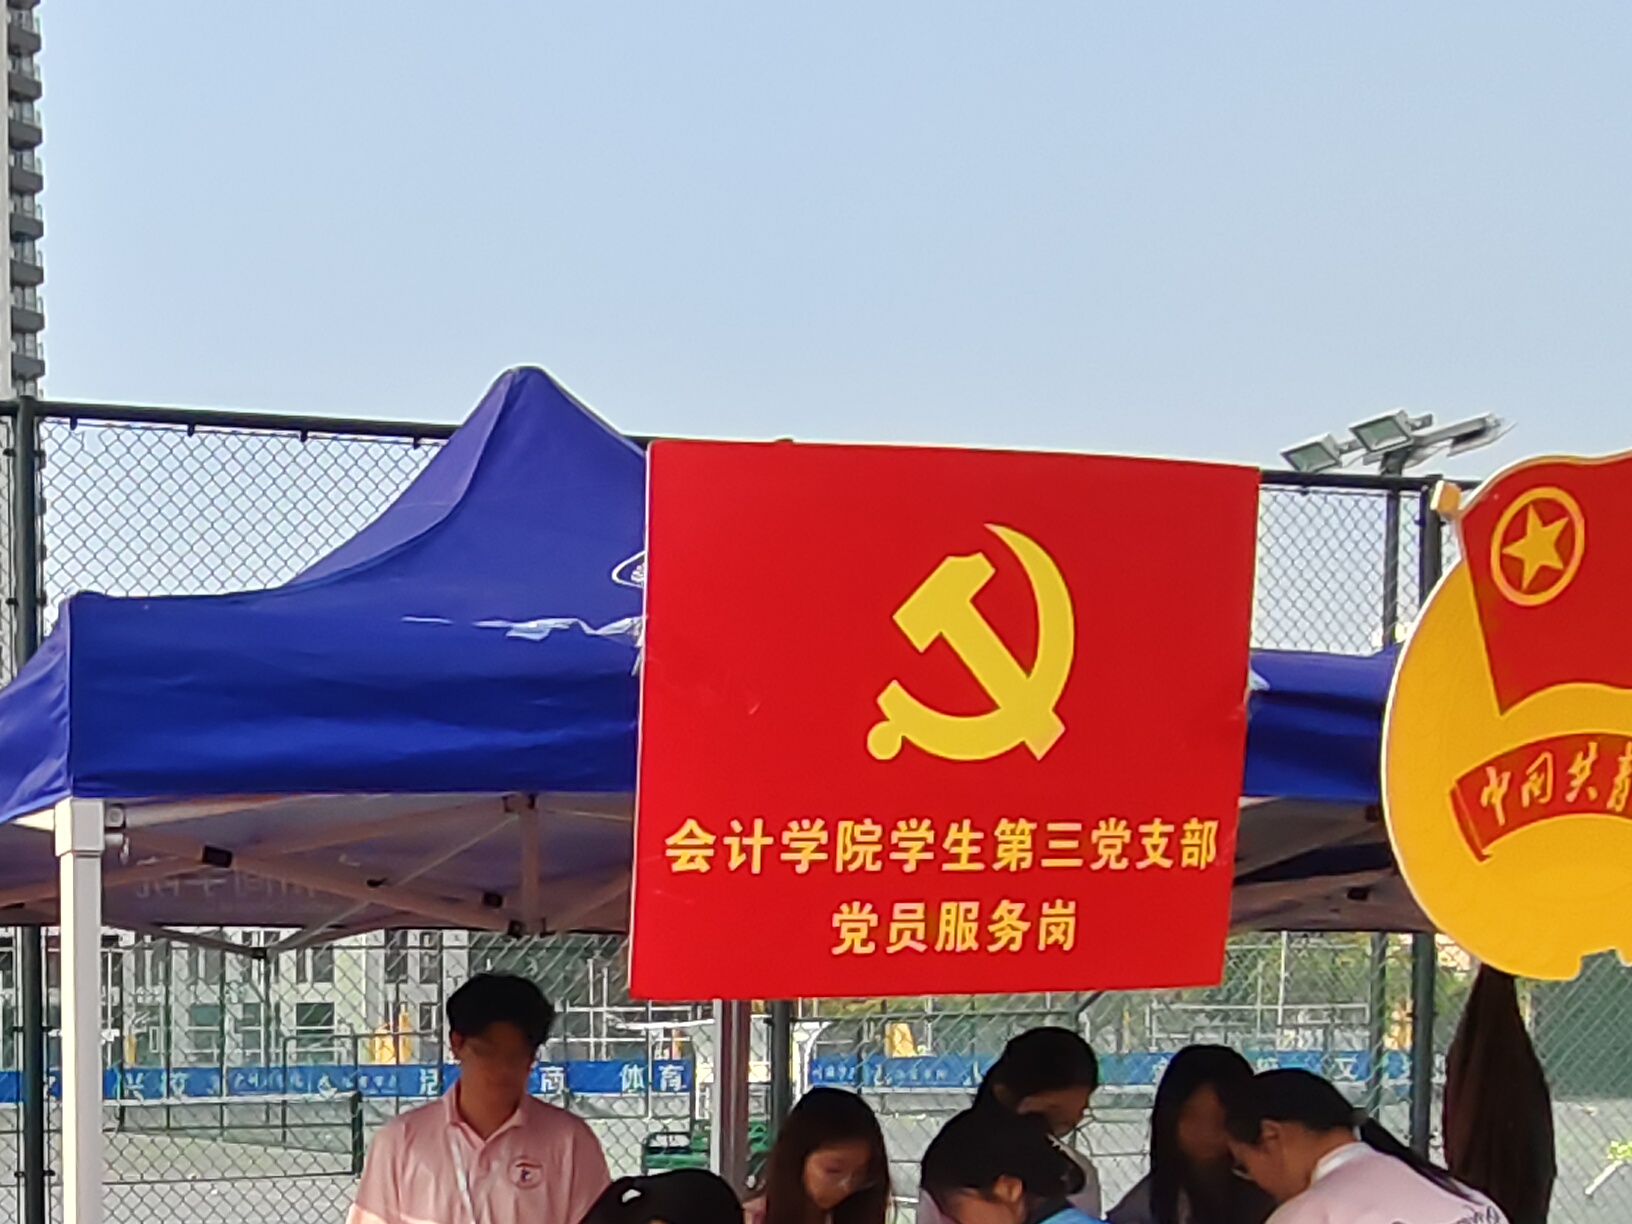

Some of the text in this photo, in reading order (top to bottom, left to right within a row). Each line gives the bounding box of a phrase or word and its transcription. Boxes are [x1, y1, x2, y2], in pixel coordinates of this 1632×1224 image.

[664, 817, 1220, 875] 会计学院学生第三党支部
[830, 899, 1078, 956] 党员服务岗
